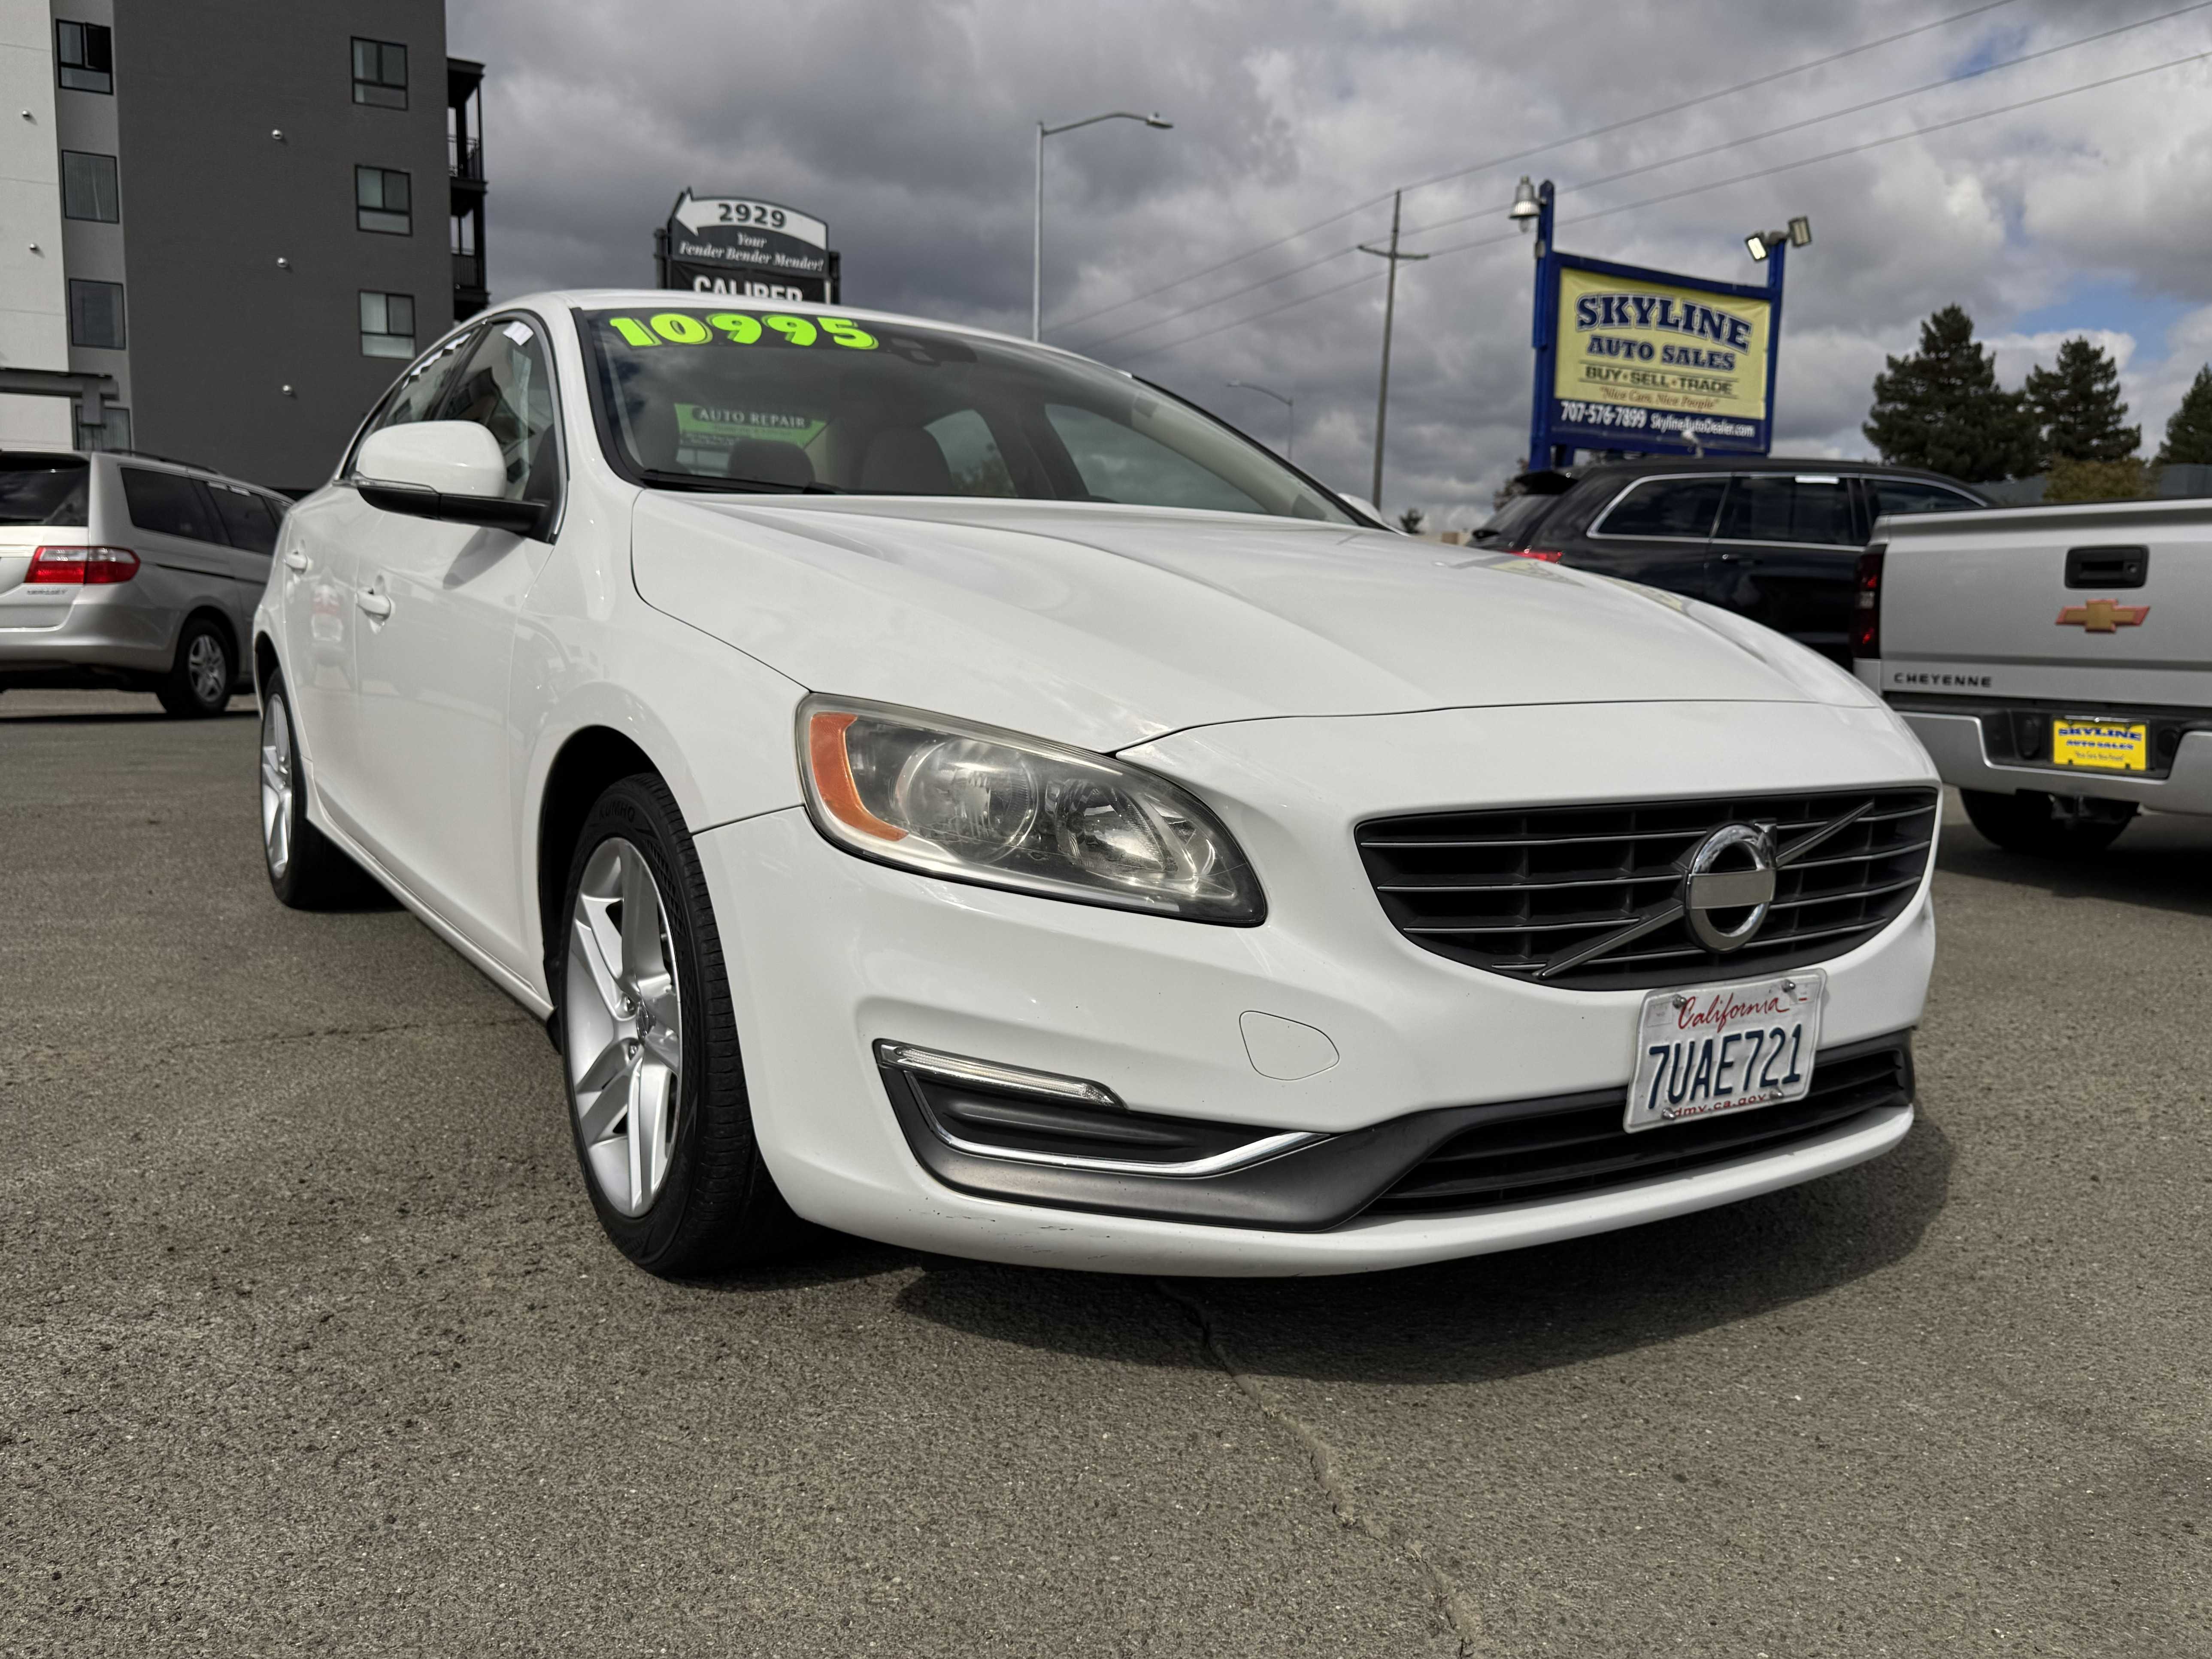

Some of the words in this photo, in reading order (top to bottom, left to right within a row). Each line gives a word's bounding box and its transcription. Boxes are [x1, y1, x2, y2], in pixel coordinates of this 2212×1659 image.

[718, 203, 786, 229] 2929
[737, 232, 767, 248] Your
[679, 240, 724, 257] Fender
[726, 245, 772, 264] Bender
[773, 252, 824, 272] Mender!
[609, 313, 879, 349] 10995
[1576, 293, 1752, 355] SKYLINE
[1587, 335, 1654, 361] AUTO
[1661, 345, 1735, 371] SALES
[1585, 366, 1622, 380] BUY
[1630, 371, 1670, 388] SELL
[1679, 377, 1733, 394] TRADE
[700, 408, 745, 423] AUTO
[751, 412, 805, 428] REPAIR
[1894, 672, 1992, 687] CHEYENNE
[1678, 993, 1789, 1032] California
[1648, 1024, 1801, 1109] 7UAE721
[1675, 1093, 1766, 1116] dmv.ca.gov
